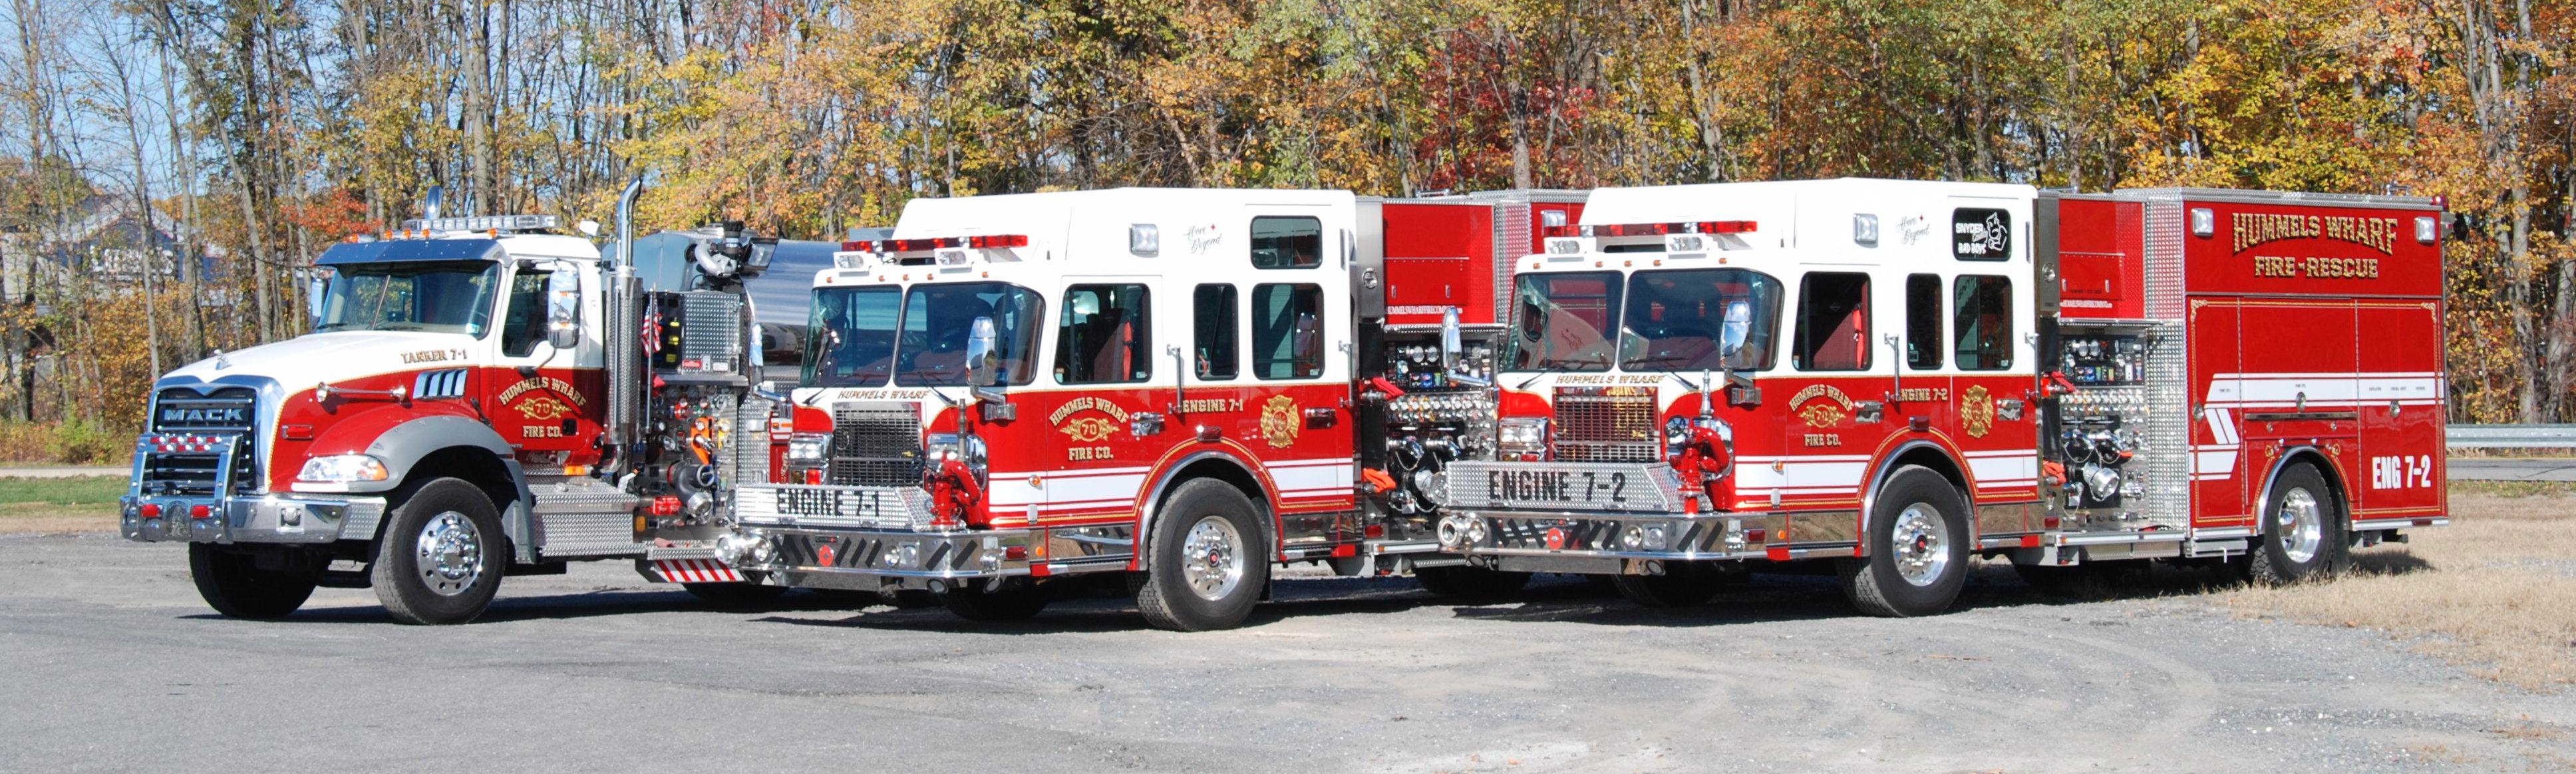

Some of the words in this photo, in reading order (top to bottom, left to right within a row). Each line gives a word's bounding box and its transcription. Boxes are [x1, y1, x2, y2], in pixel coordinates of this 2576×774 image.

[2232, 212, 2321, 254] HUMMELS
[2325, 216, 2398, 256] WHARF
[401, 350, 448, 363] TANKER
[450, 349, 468, 360] 7-1
[1556, 375, 1616, 384] HUMMELS
[1619, 375, 1665, 384] WHARF
[498, 377, 549, 405] HUMMELS
[551, 378, 587, 406] WHARF
[837, 390, 887, 399] HUMMELS
[890, 390, 929, 399] WHARF
[1788, 384, 1826, 412] HUMMELS
[1826, 385, 1854, 411] WHARF
[1900, 388, 1930, 401] NGINE
[1933, 388, 1948, 401] 7-2
[534, 403, 550, 413] 70
[1049, 397, 1094, 427] HUMMELS
[1094, 397, 1130, 424] WHARF
[1182, 399, 1226, 413] ENGINE
[1228, 398, 1243, 412] 7-1
[164, 409, 243, 420] MACK
[1816, 410, 1828, 421] 70
[522, 426, 545, 437] FIRE
[546, 426, 563, 437] CO.
[1081, 424, 1097, 435] 70
[1804, 433, 1825, 447] FIRE
[1826, 433, 1842, 445] CO.
[1068, 447, 1093, 461] FIRE
[1094, 447, 1114, 459] CO.
[2372, 455, 2402, 490] ENG
[2404, 455, 2431, 488] 7-2
[1488, 470, 1571, 501] ENGINE
[1583, 471, 1626, 502] 7-2
[776, 488, 843, 516] ENGINE
[854, 490, 880, 517] 7-1
